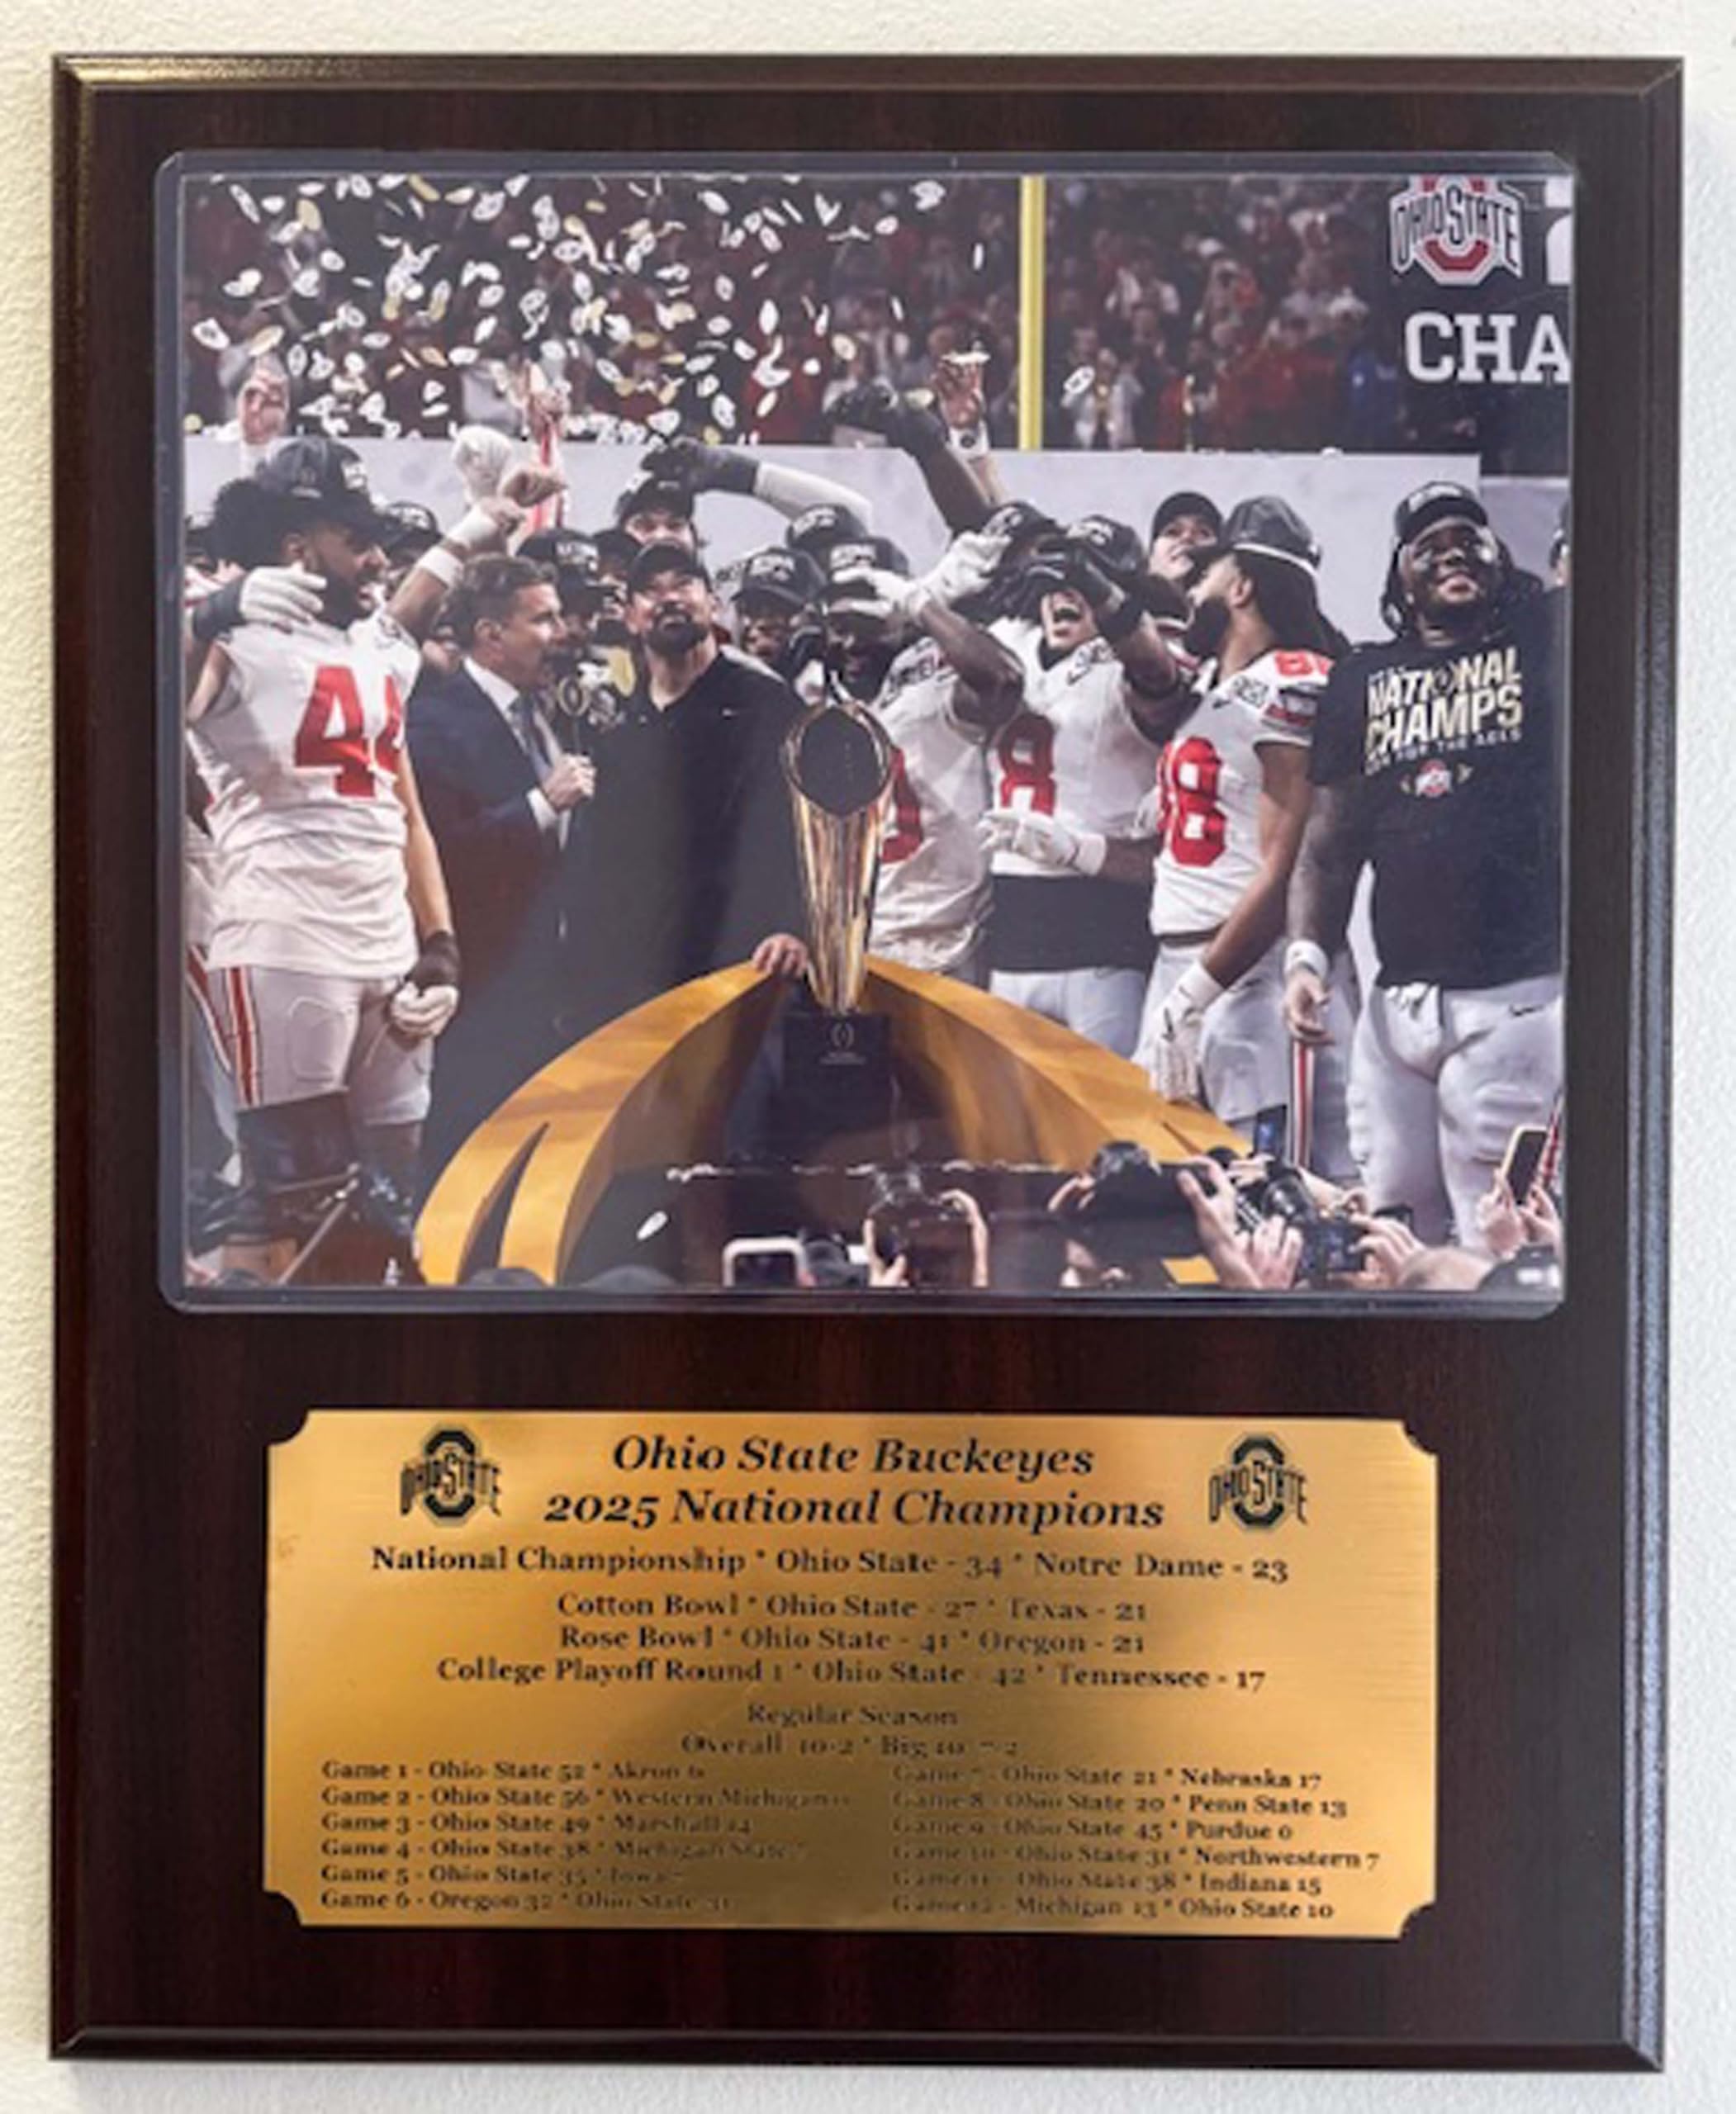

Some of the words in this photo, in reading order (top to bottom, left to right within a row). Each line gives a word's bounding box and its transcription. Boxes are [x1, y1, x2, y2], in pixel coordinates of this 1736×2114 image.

[1406, 310, 1571, 383] CHA
[1365, 685, 1522, 756] CHAMPS
[613, 1435, 725, 1472] Ohio
[738, 1436, 859, 1473] State
[873, 1438, 1095, 1484] Buckeyes
[544, 1495, 660, 1529] 2025
[670, 1488, 880, 1524] National
[893, 1489, 1165, 1534] Champions
[371, 1545, 507, 1571] National
[517, 1545, 746, 1577] Championship
[776, 1548, 851, 1573] Ohio
[858, 1549, 939, 1573] State
[964, 1556, 1003, 1579] 34
[1035, 1552, 1122, 1577] Notre
[1135, 1552, 1224, 1578] Dame
[1252, 1559, 1289, 1584] 23
[557, 1591, 655, 1617] Cotton
[665, 1592, 739, 1616] Bowl
[766, 1592, 837, 1617] Ohio
[842, 1594, 919, 1619] State
[1009, 1597, 1088, 1620] Texas
[1115, 1602, 1146, 1622] 21
[561, 1624, 629, 1649] Rose
[639, 1625, 714, 1650] Bowl
[741, 1625, 810, 1650] Ohio
[818, 1627, 891, 1651] State
[920, 1633, 949, 1654] 41
[978, 1629, 1086, 1657] Oregon
[1112, 1634, 1145, 1655] 21
[436, 1655, 547, 1685] College
[555, 1656, 659, 1687] Playoff
[666, 1658, 762, 1683] Round
[812, 1659, 882, 1684] Ohio
[889, 1661, 965, 1685] State
[991, 1667, 1026, 1688] 42
[1056, 1662, 1210, 1689] Tennessee
[1236, 1670, 1267, 1693] 17
[747, 1703, 852, 1728] Regular
[859, 1705, 958, 1727] Season
[681, 1731, 782, 1756] Overall
[799, 1738, 856, 1756] 10-2
[880, 1734, 928, 1760] Big
[320, 1759, 391, 1780] Game
[397, 1764, 407, 1780] 1
[427, 1760, 487, 1780] Ohio
[495, 1761, 553, 1780] State
[557, 1764, 585, 1784] 52
[609, 1761, 680, 1780] Akron
[892, 1764, 962, 1784] Game
[1002, 1764, 1060, 1784] Ohio
[1064, 1766, 1123, 1785] State
[1132, 1770, 1156, 1787] 21
[1180, 1768, 1292, 1789] Nebraska
[1299, 1774, 1322, 1792] 17
[320, 1785, 391, 1806] Game
[396, 1790, 410, 1807] 2
[429, 1785, 491, 1806] Ohio
[495, 1787, 554, 1807] State
[558, 1789, 591, 1808] 56
[611, 1787, 714, 1808] Western
[892, 1789, 966, 1810] Game
[1004, 1790, 1062, 1810] Ohio
[1066, 1792, 1126, 1812] State
[1134, 1797, 1166, 1813] 20
[1188, 1794, 1248, 1814] Penn
[1254, 1794, 1315, 1816] State
[1321, 1800, 1349, 1820] 13
[320, 1812, 391, 1832] Game
[395, 1818, 410, 1836] 3
[429, 1812, 491, 1832] Ohio
[495, 1813, 554, 1833] State
[560, 1818, 591, 1837] 49
[614, 1813, 721, 1833] Marshall
[892, 1816, 965, 1837] Game
[1003, 1817, 1062, 1837] Ohio
[1066, 1818, 1126, 1837] State
[1134, 1822, 1164, 1843] 45
[1186, 1820, 1272, 1841] Purdue
[1278, 1824, 1294, 1841] 0
[320, 1837, 391, 1857] Game
[395, 1841, 411, 1860] 4
[429, 1838, 491, 1857] Ohio
[495, 1839, 555, 1858] State
[559, 1841, 591, 1860] 38
[892, 1843, 961, 1863] Game
[1014, 1844, 1074, 1863] Ohio
[1077, 1845, 1139, 1864] State
[1144, 1850, 1170, 1870] 31
[1196, 1846, 1362, 1870] Northwestern
[1364, 1852, 1381, 1872] 7
[320, 1864, 390, 1884] Game
[395, 1868, 410, 1887] 5
[428, 1864, 491, 1884] Ohio
[495, 1865, 553, 1884] State
[892, 1869, 961, 1889] Game
[1016, 1869, 1074, 1889] Ohio
[1079, 1870, 1139, 1890] State
[1145, 1873, 1177, 1894] 38
[1200, 1872, 1292, 1893] Indiana
[1297, 1878, 1322, 1898] 15
[320, 1889, 391, 1909] Game
[396, 1890, 410, 1910] 6
[429, 1889, 520, 1913] Oregon
[575, 1891, 636, 1911] Ohio
[1016, 1896, 1123, 1920] Michigan
[1179, 1898, 1237, 1918] Ohio
[1241, 1899, 1302, 1920] State
[1307, 1904, 1335, 1921] 10
